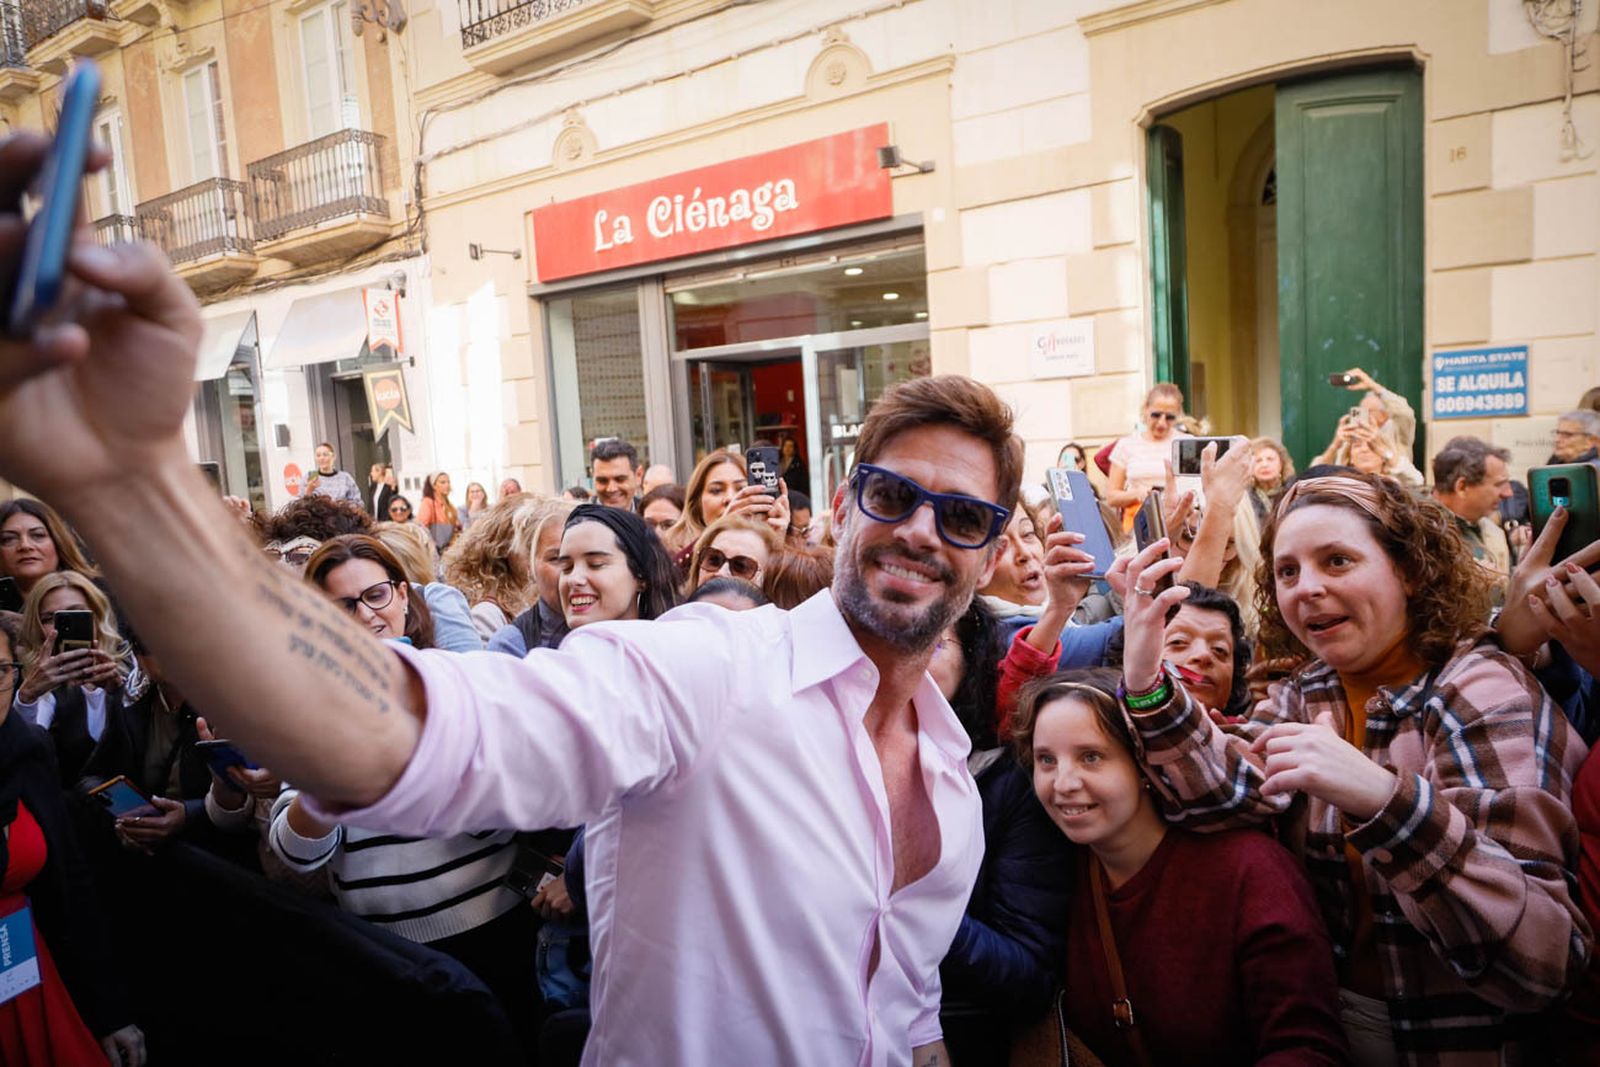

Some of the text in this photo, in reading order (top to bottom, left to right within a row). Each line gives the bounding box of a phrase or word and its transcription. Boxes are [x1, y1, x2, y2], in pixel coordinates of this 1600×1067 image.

[594, 178, 799, 252] La Ciénaga
[1445, 351, 1526, 366] HABITA STATE
[1435, 371, 1525, 393] SE ALQUILA
[0, 923, 12, 967] PRENSA
